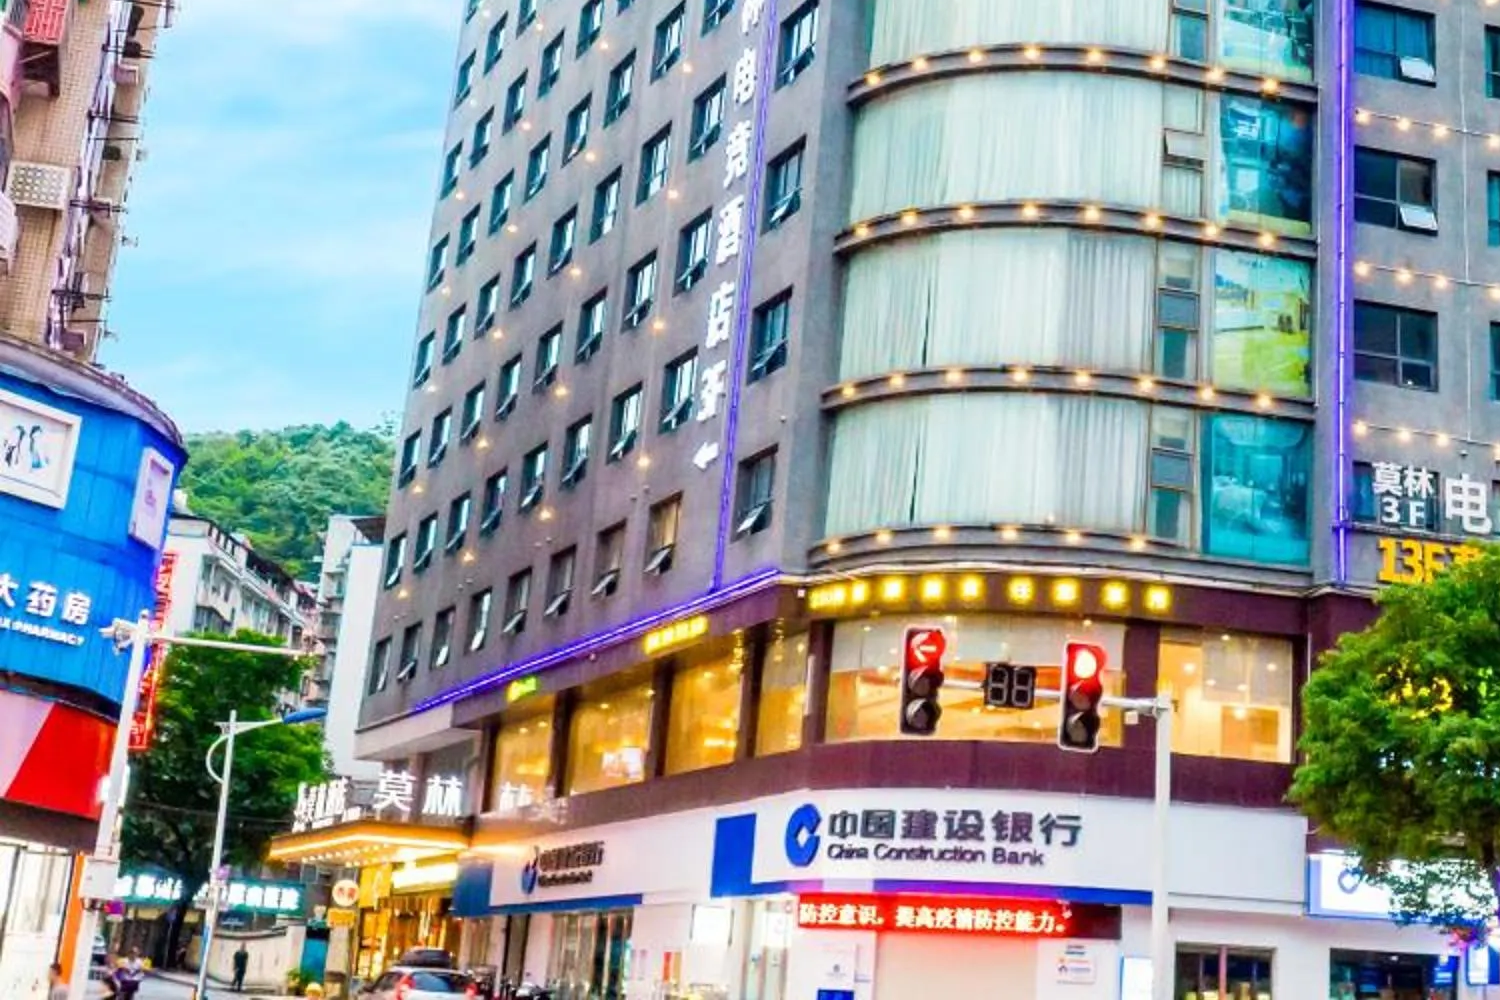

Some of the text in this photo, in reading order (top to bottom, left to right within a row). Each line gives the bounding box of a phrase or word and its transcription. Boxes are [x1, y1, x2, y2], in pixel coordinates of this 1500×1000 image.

[1371, 461, 1435, 499] 莫林
[1381, 496, 1425, 527] 3F
[373, 769, 463, 817] 莫林
[828, 808, 1082, 847] 中国建设银行
[827, 842, 1045, 866] China Construction Bank
